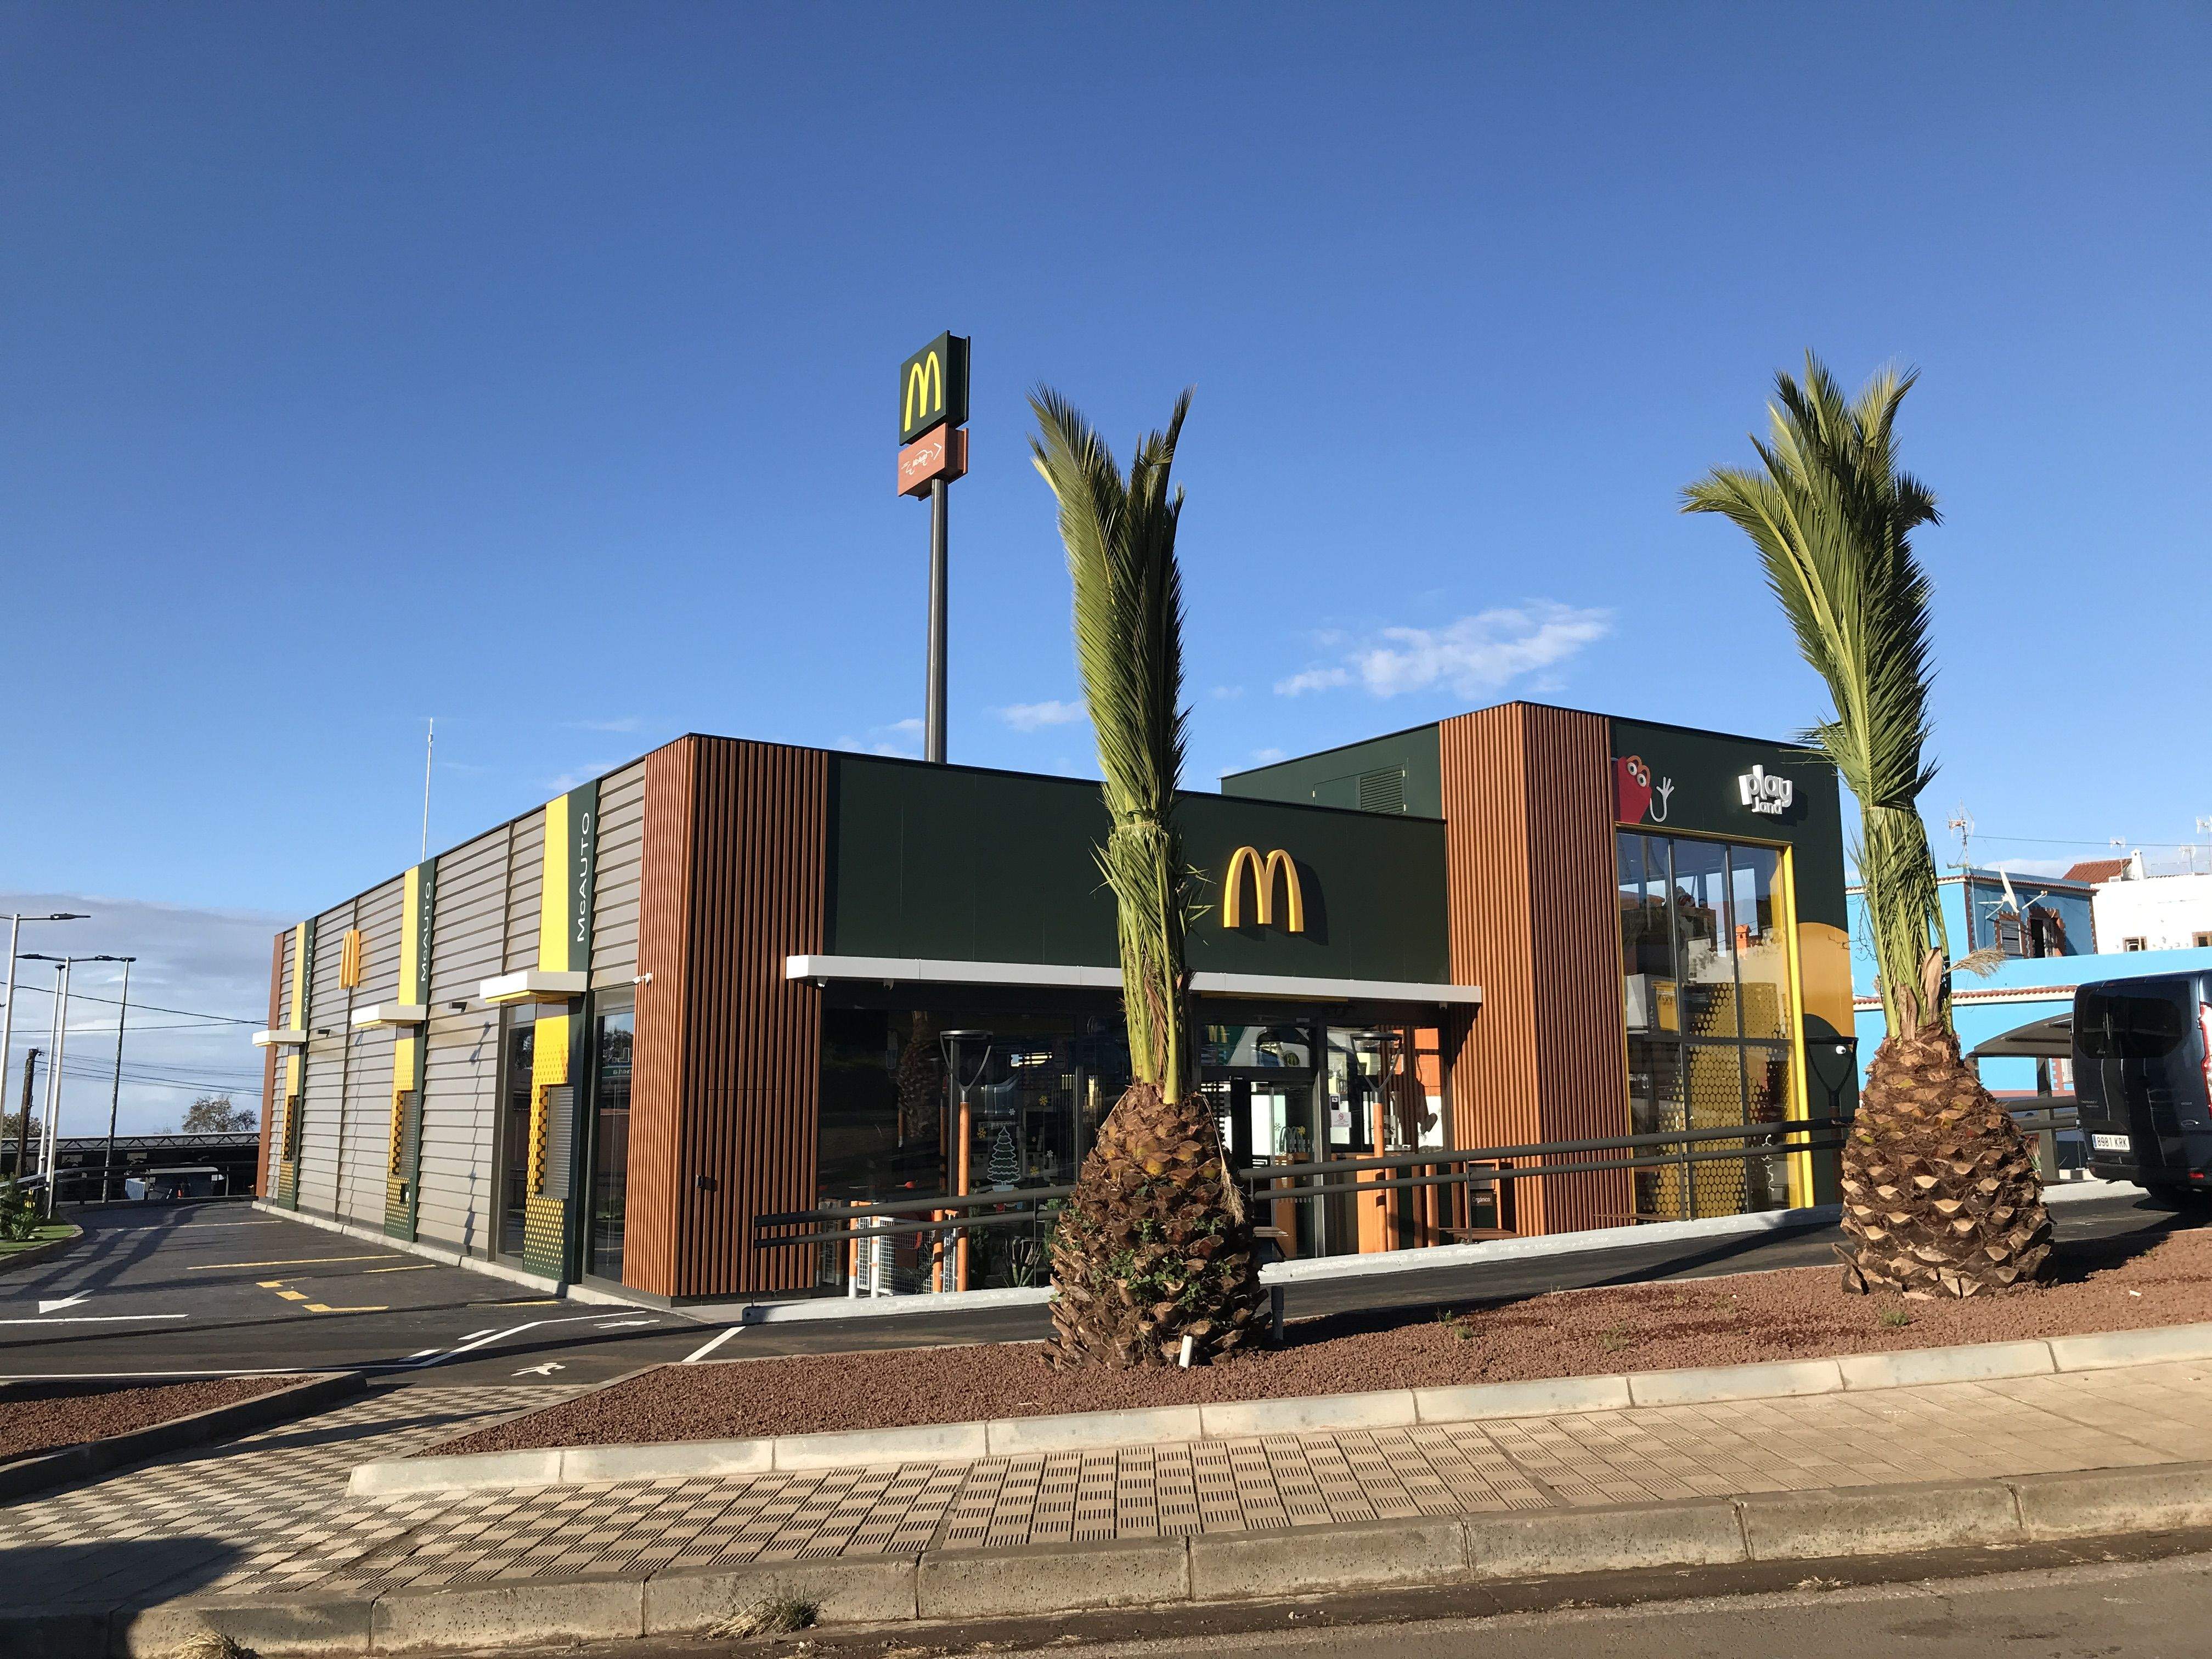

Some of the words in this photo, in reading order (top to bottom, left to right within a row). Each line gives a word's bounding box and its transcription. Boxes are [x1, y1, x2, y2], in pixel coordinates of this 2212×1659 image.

[1738, 764, 1792, 808] play
[2097, 1136, 2113, 1147] 8981
[2114, 1137, 2128, 1148] KRK
